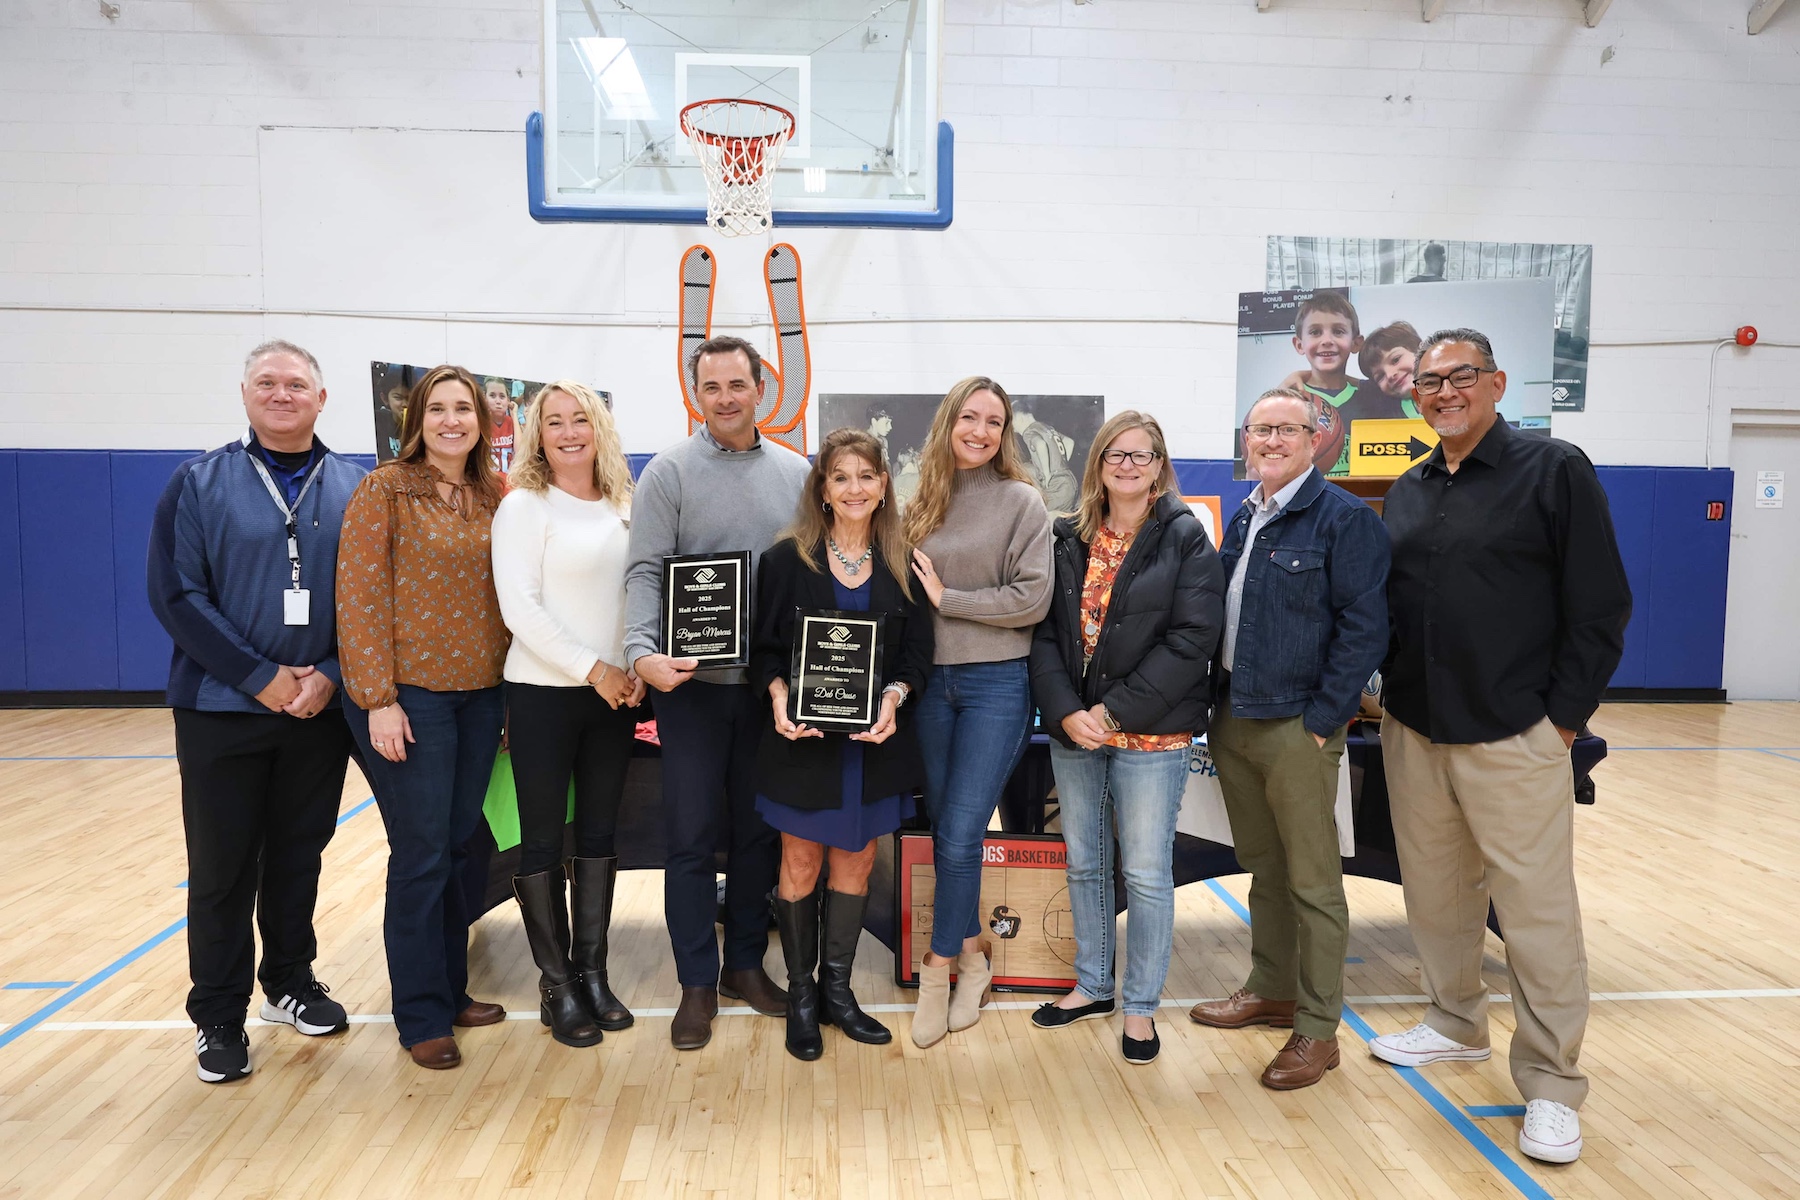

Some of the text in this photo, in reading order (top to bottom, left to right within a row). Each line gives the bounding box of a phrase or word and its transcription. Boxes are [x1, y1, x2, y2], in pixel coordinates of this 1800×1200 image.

[1362, 444, 1412, 455] POSS.
[831, 666, 865, 674] Champions
[1007, 849, 1068, 864] BASKETBA
